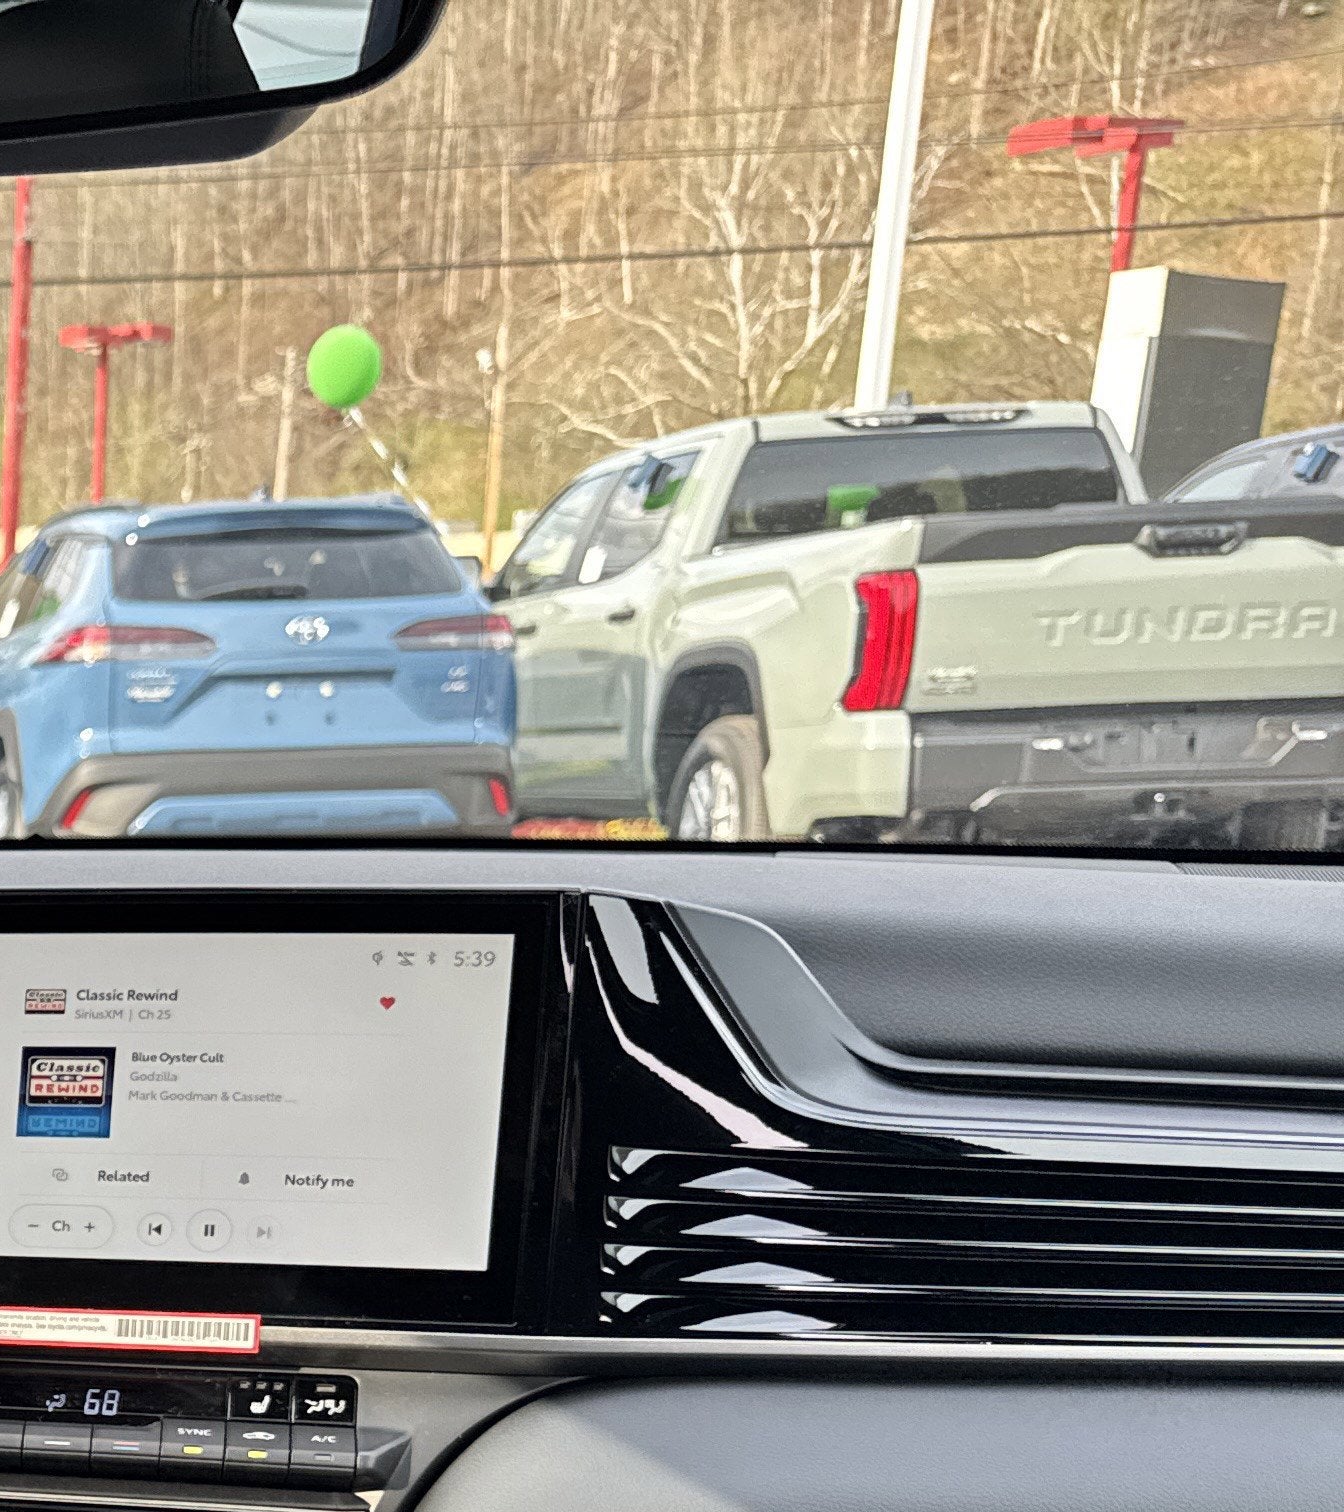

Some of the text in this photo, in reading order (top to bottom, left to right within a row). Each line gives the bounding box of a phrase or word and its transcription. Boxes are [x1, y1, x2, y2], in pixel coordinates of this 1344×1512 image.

[1032, 600, 1338, 647] TUNDRA
[453, 950, 497, 968] 5:39
[76, 989, 179, 1001] Classic Rewind
[74, 1009, 171, 1020] SiriusXM Ch 25
[131, 1052, 224, 1065] Blue Oyster Cult
[35, 1061, 100, 1073] Classic
[130, 1071, 178, 1082] Godzilla
[34, 1083, 100, 1093] REWIND
[128, 1090, 158, 1101] Mark
[160, 1091, 217, 1102] Goodman
[97, 1169, 150, 1182] Related
[284, 1173, 355, 1190] Notify me
[51, 1219, 70, 1232] Ch
[84, 1388, 121, 1416] 68
[177, 1427, 212, 1437] SYNC
[310, 1434, 337, 1444] A/C
